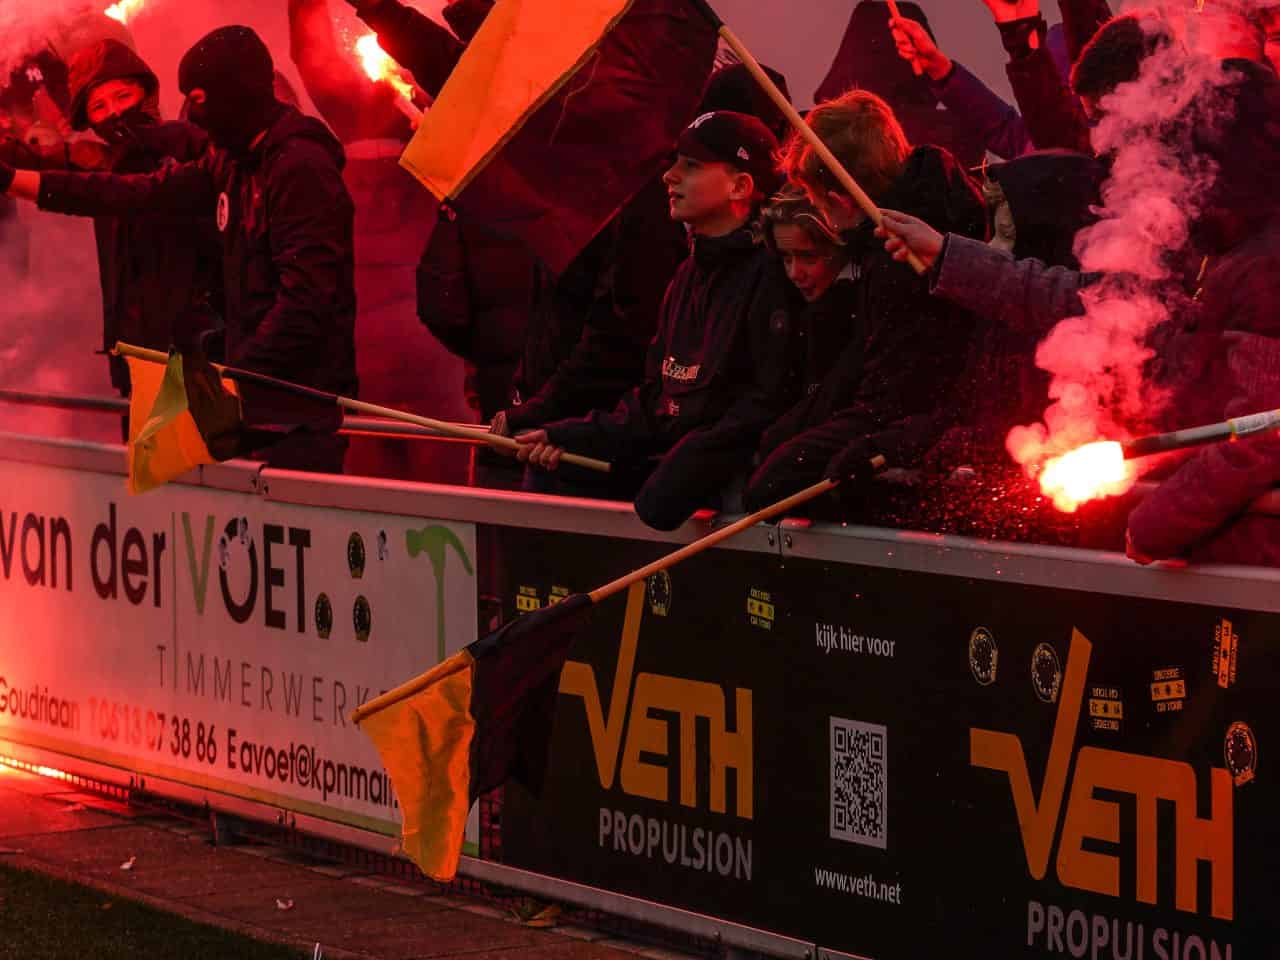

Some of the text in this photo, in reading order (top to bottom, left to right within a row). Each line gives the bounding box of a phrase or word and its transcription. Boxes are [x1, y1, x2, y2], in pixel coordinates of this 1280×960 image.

[90, 502, 166, 608] der
[181, 511, 311, 633] VOET
[815, 622, 896, 657] kijk hier voor
[156, 644, 388, 731] TIMMERWERK
[558, 580, 753, 820] VETH
[170, 714, 191, 759] 38
[196, 720, 217, 765] 86
[970, 627, 1234, 921] VETH
[599, 807, 753, 881] PROPULSION
[814, 866, 901, 905] www.veth.net
